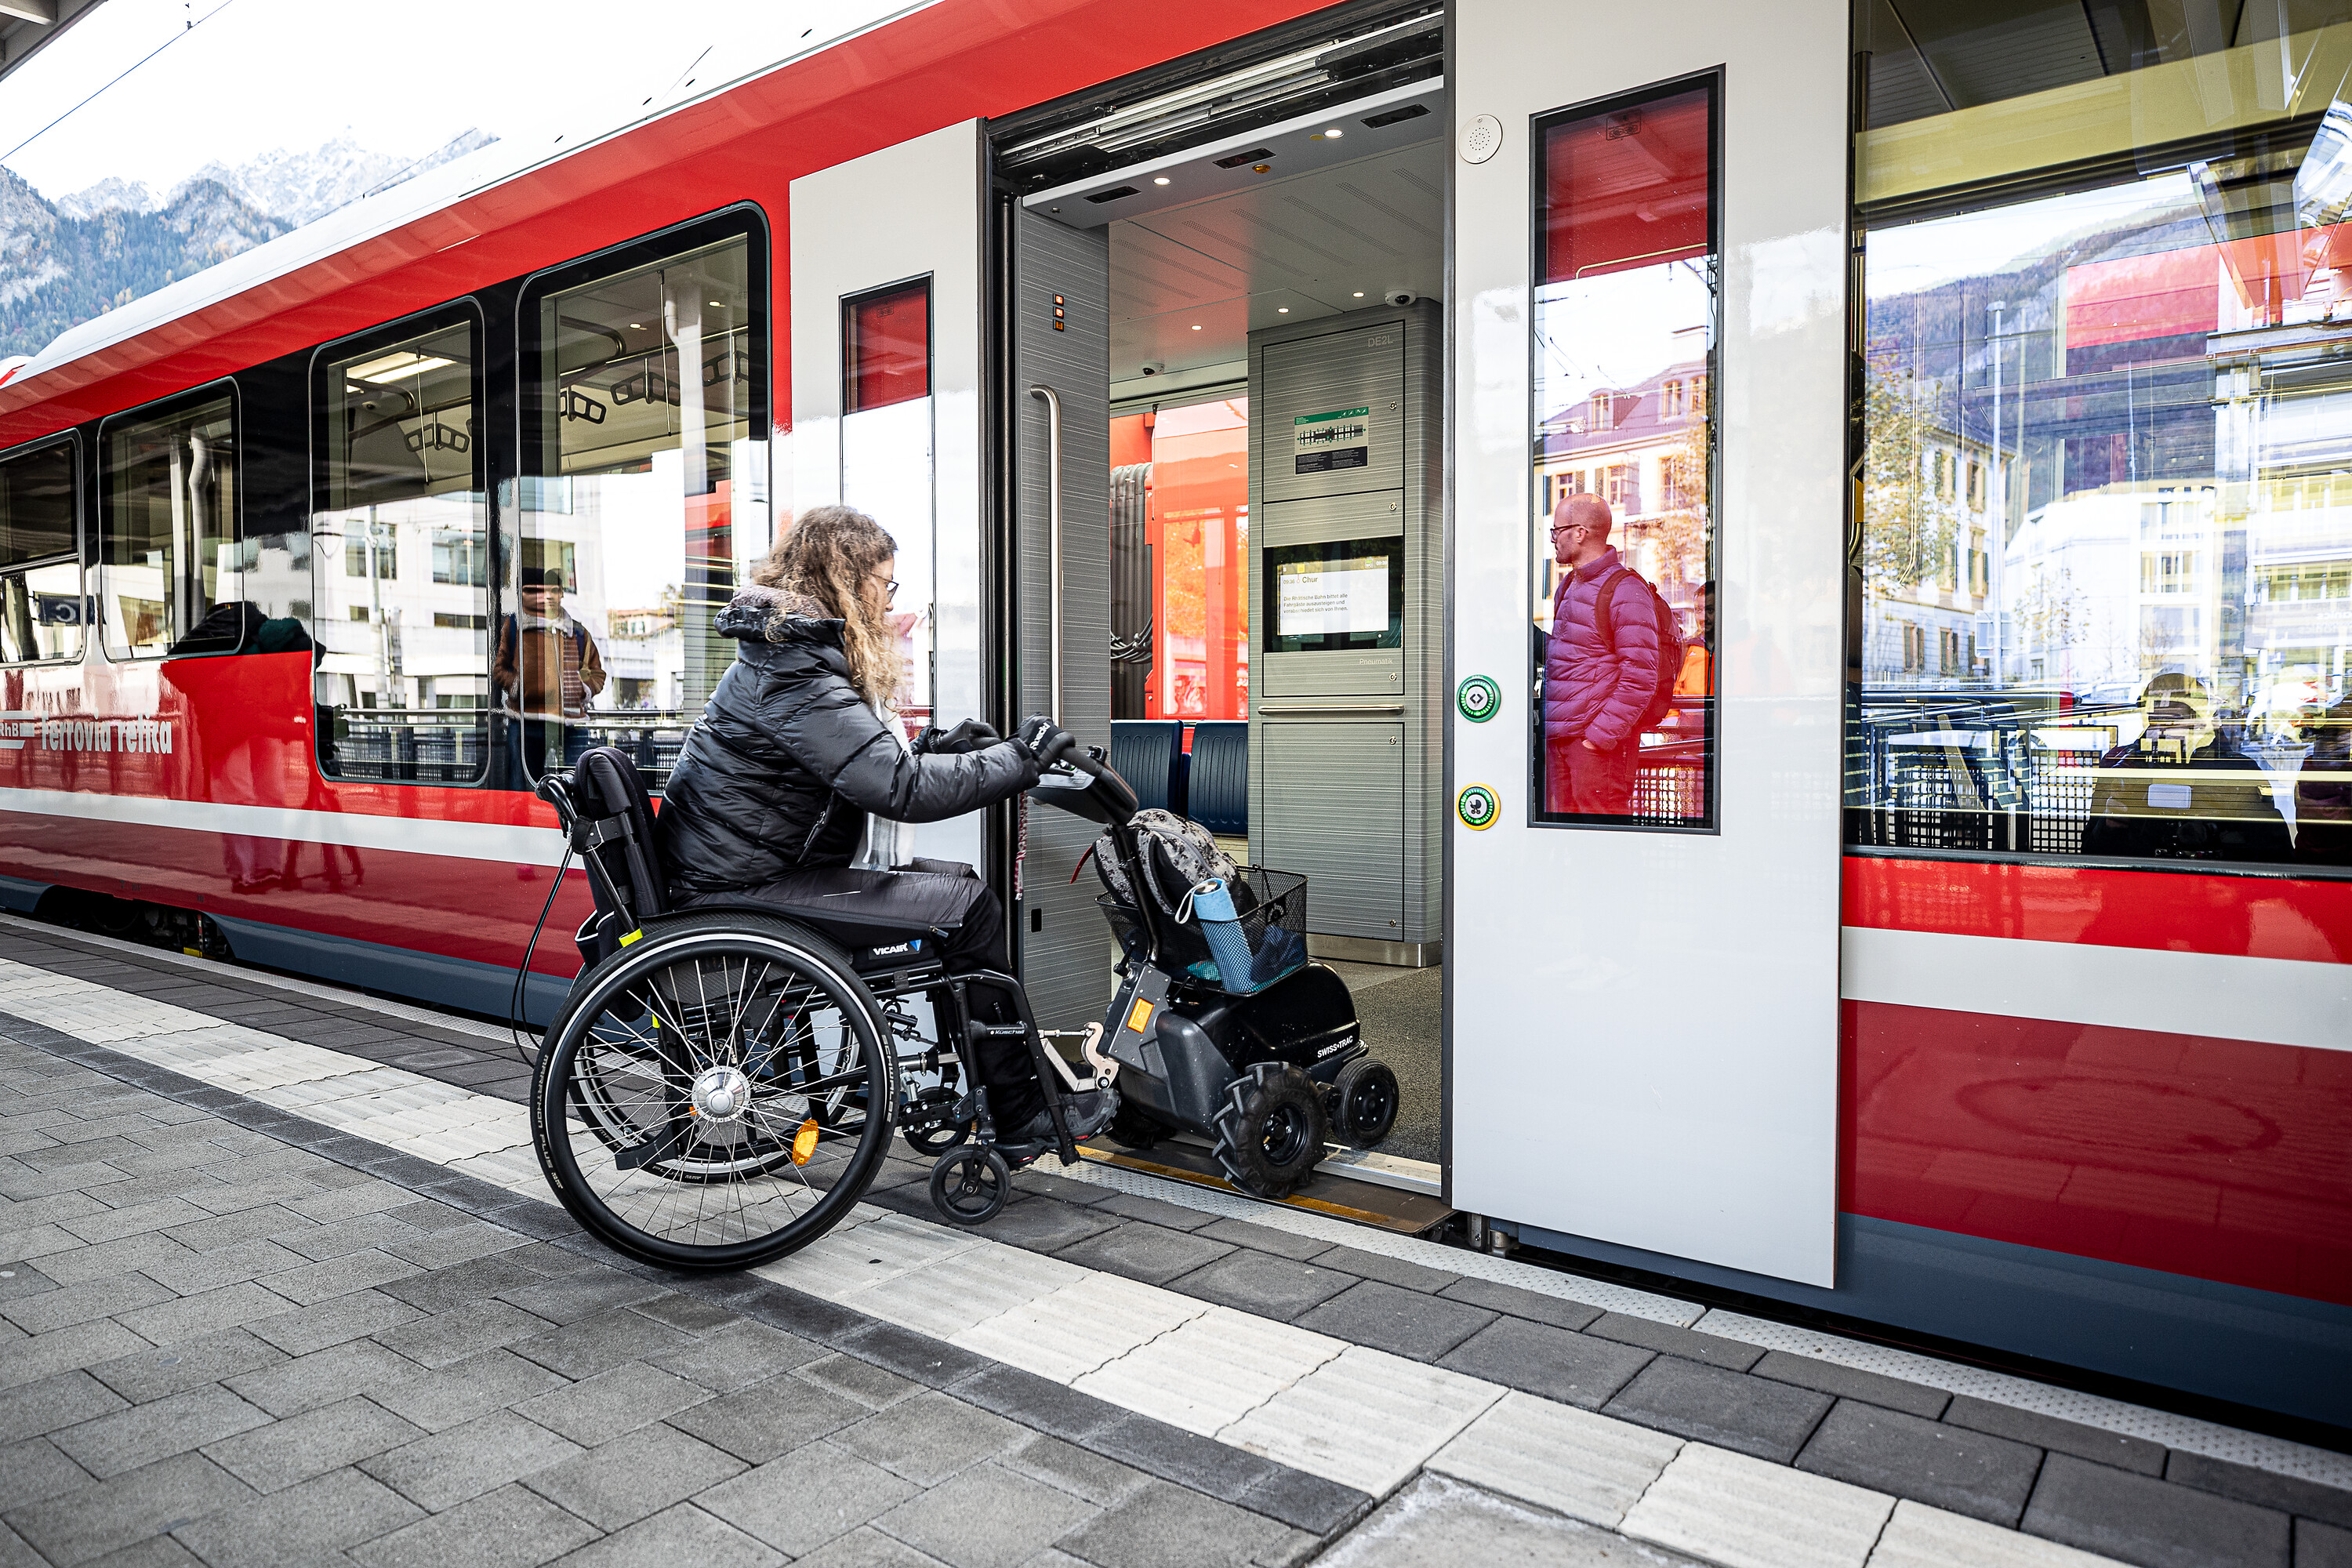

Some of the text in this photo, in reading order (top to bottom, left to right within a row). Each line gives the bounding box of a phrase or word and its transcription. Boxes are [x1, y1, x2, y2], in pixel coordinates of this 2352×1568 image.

[0, 722, 19, 737] RhB
[118, 707, 172, 754] retica
[873, 942, 909, 956] VICAIR
[881, 1034, 895, 1123] SCHWALBE
[536, 1054, 554, 1169] MARATHON PLUS
